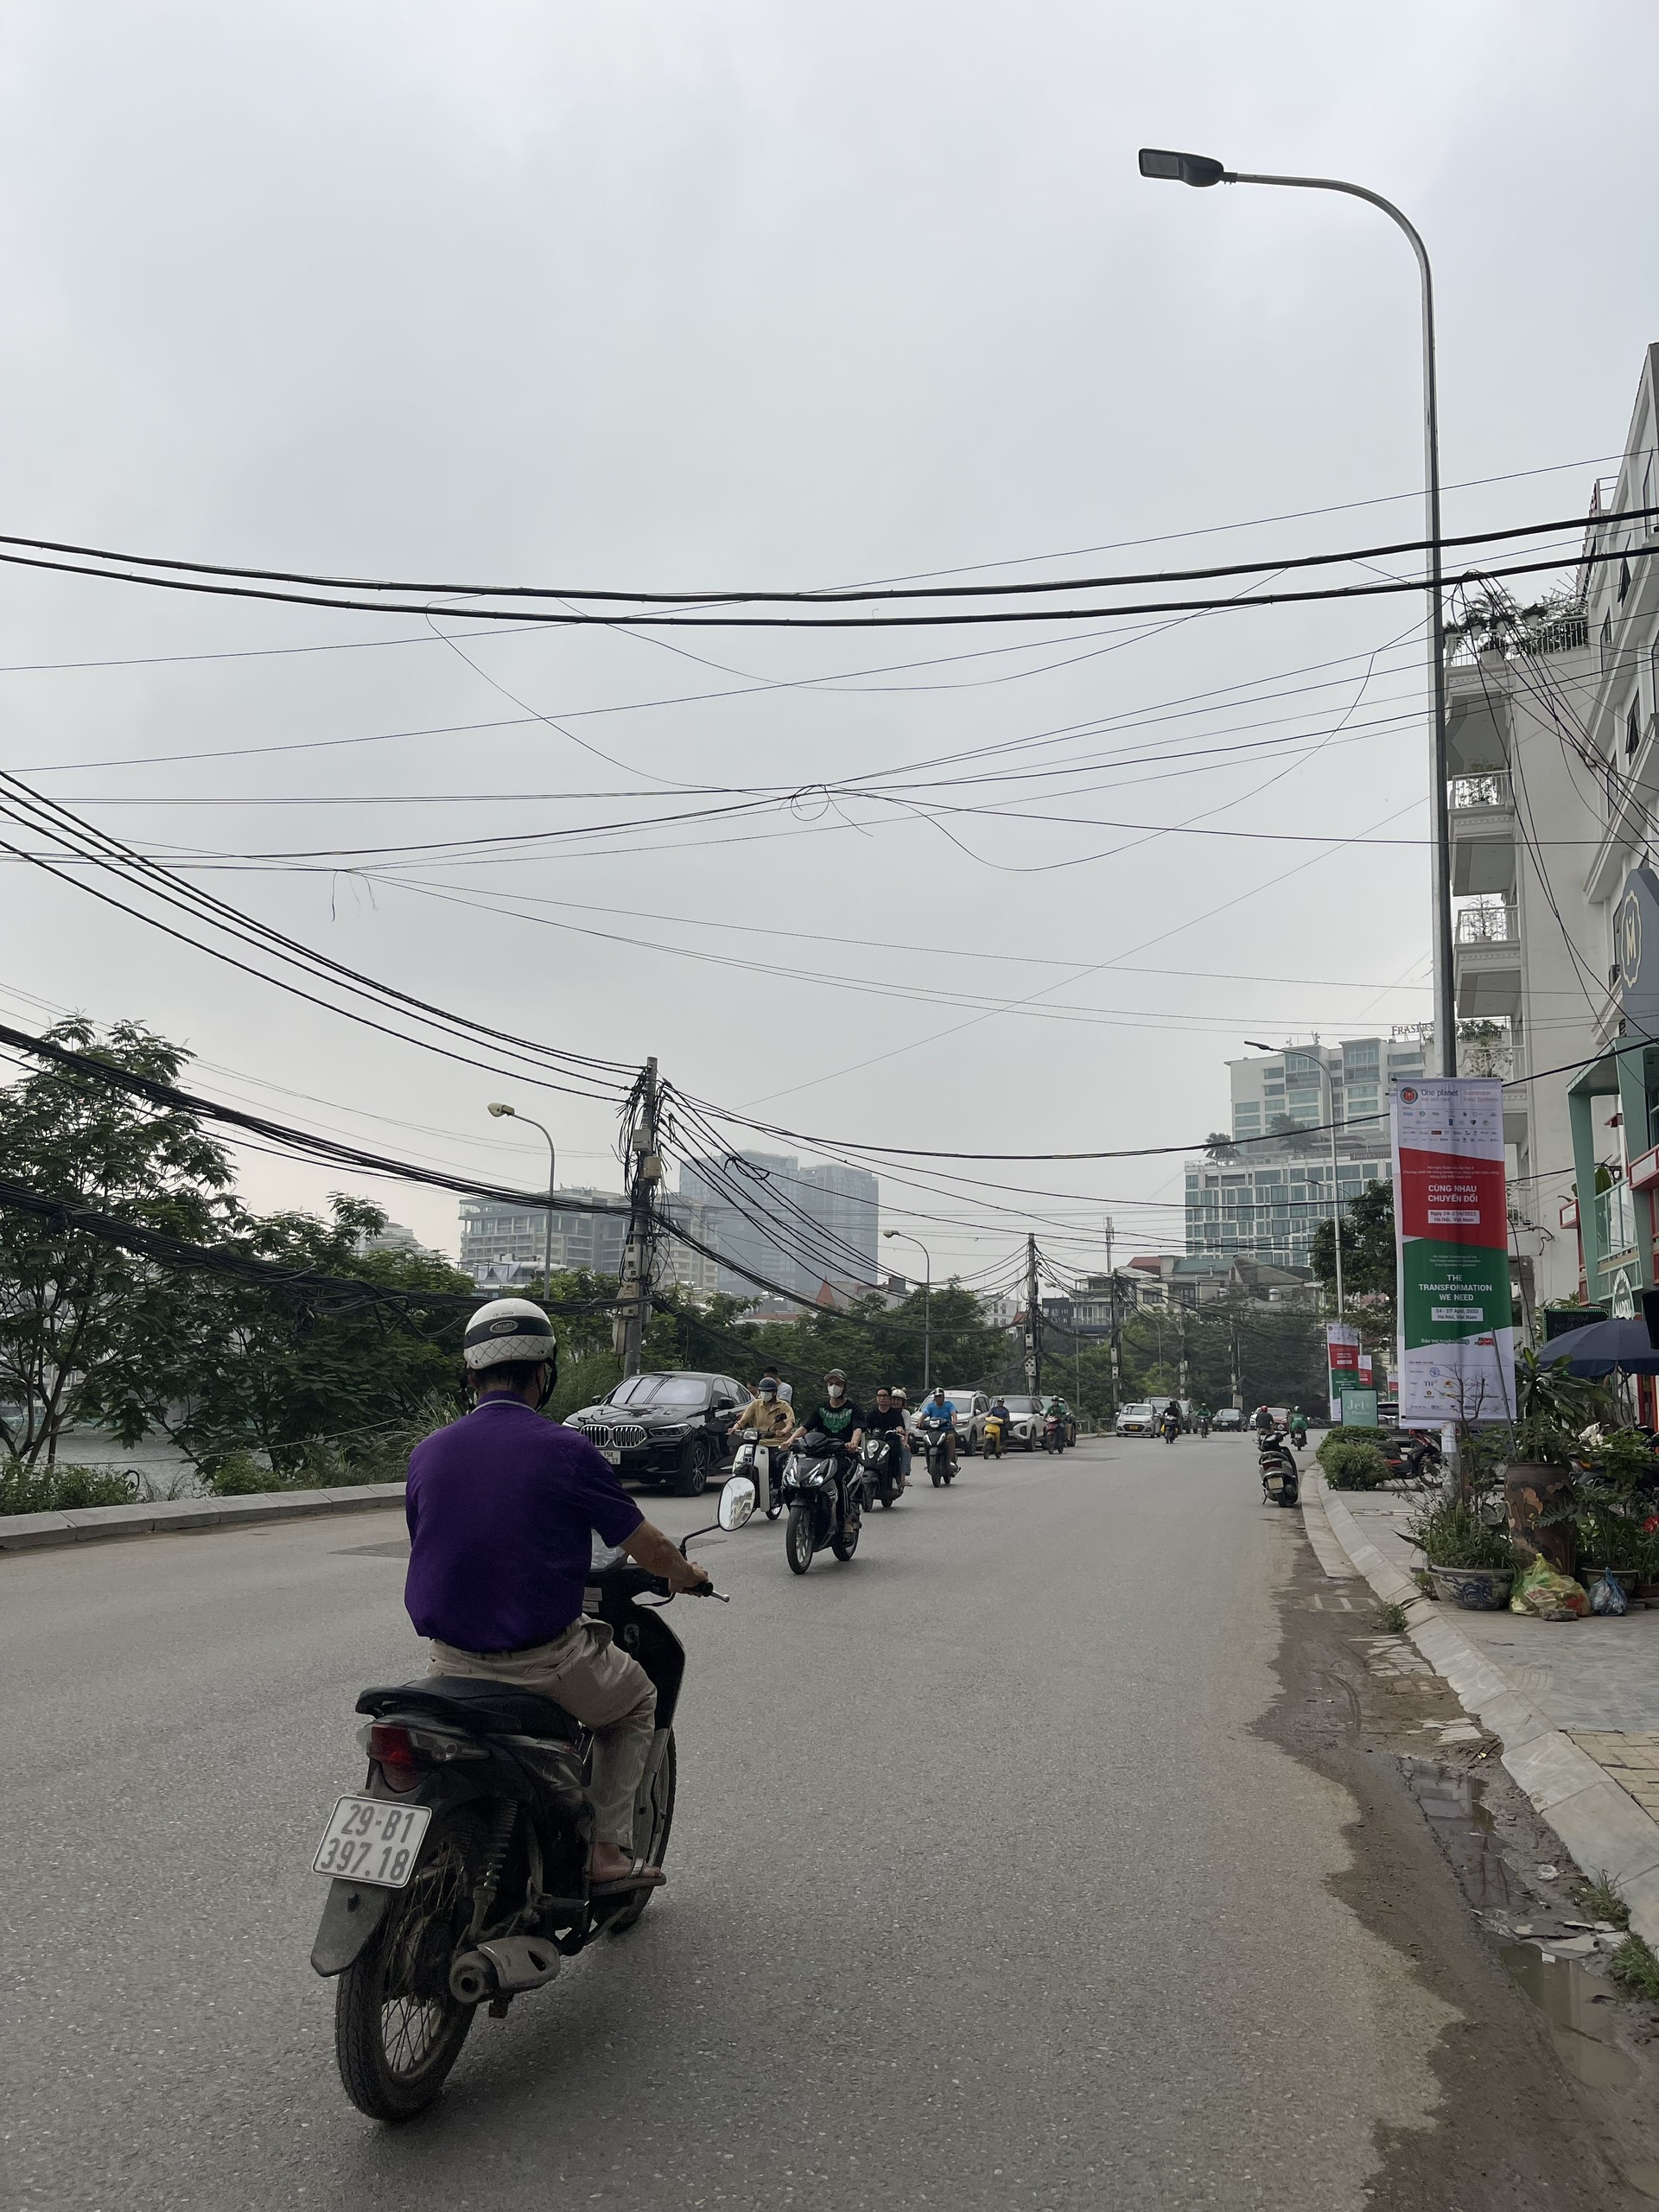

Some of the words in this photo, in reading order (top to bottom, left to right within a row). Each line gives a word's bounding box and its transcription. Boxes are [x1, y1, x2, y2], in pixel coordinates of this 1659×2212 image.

[1428, 1183, 1452, 1192] CÙNG
[341, 1803, 415, 1843] 29-B1
[321, 1837, 410, 1881] 397.18
